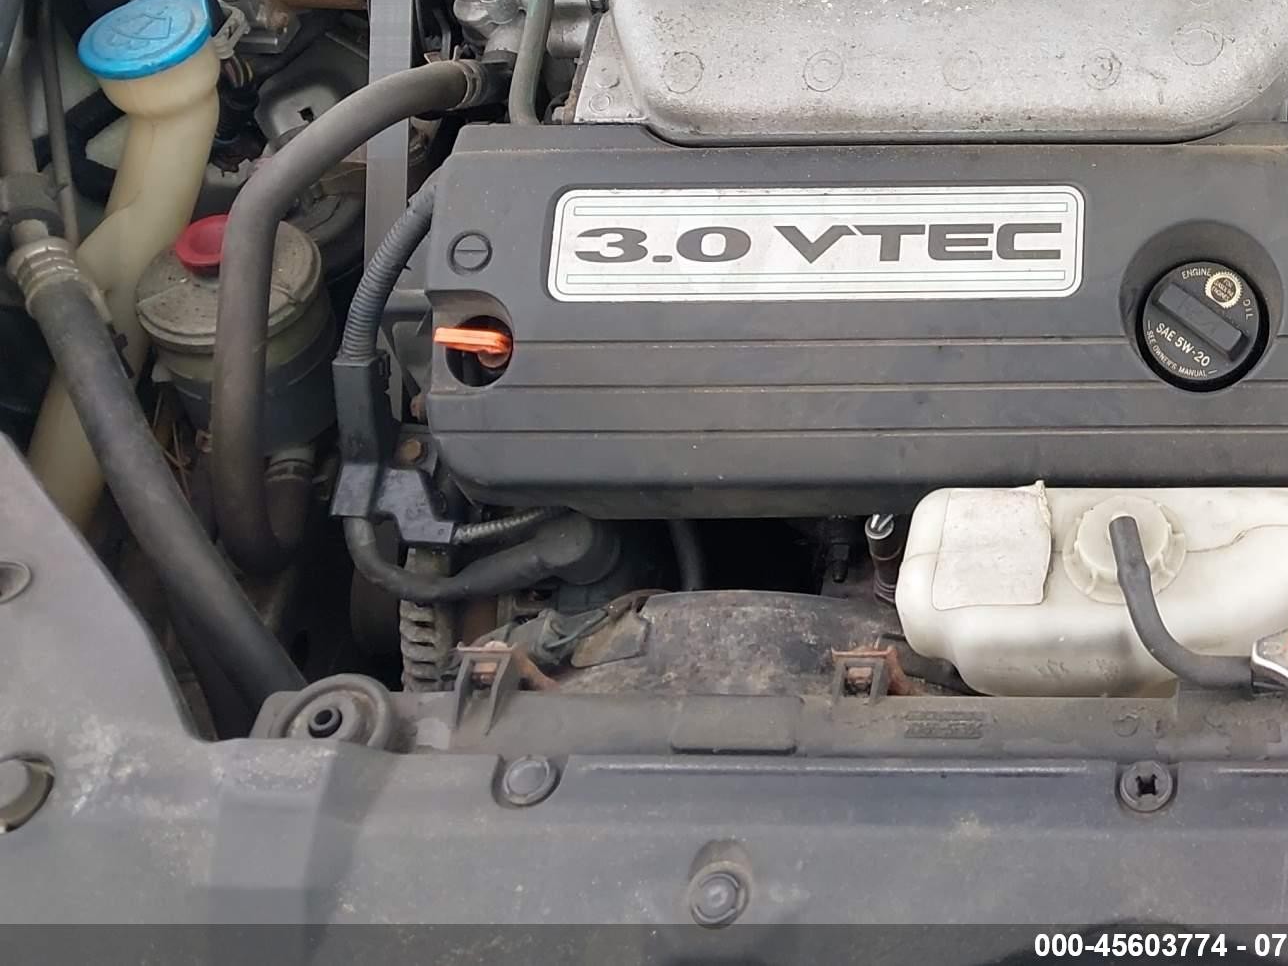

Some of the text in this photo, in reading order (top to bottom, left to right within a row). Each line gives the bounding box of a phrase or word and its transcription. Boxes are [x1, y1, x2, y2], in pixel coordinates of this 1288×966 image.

[574, 222, 1063, 264] 3.0 VTEC
[1181, 267, 1212, 280] ENGINE
[1242, 298, 1254, 321] OIL
[1146, 330, 1157, 345] SEE
[1178, 365, 1207, 378] MANUAL
[1155, 322, 1211, 367] SAE 5W-20
